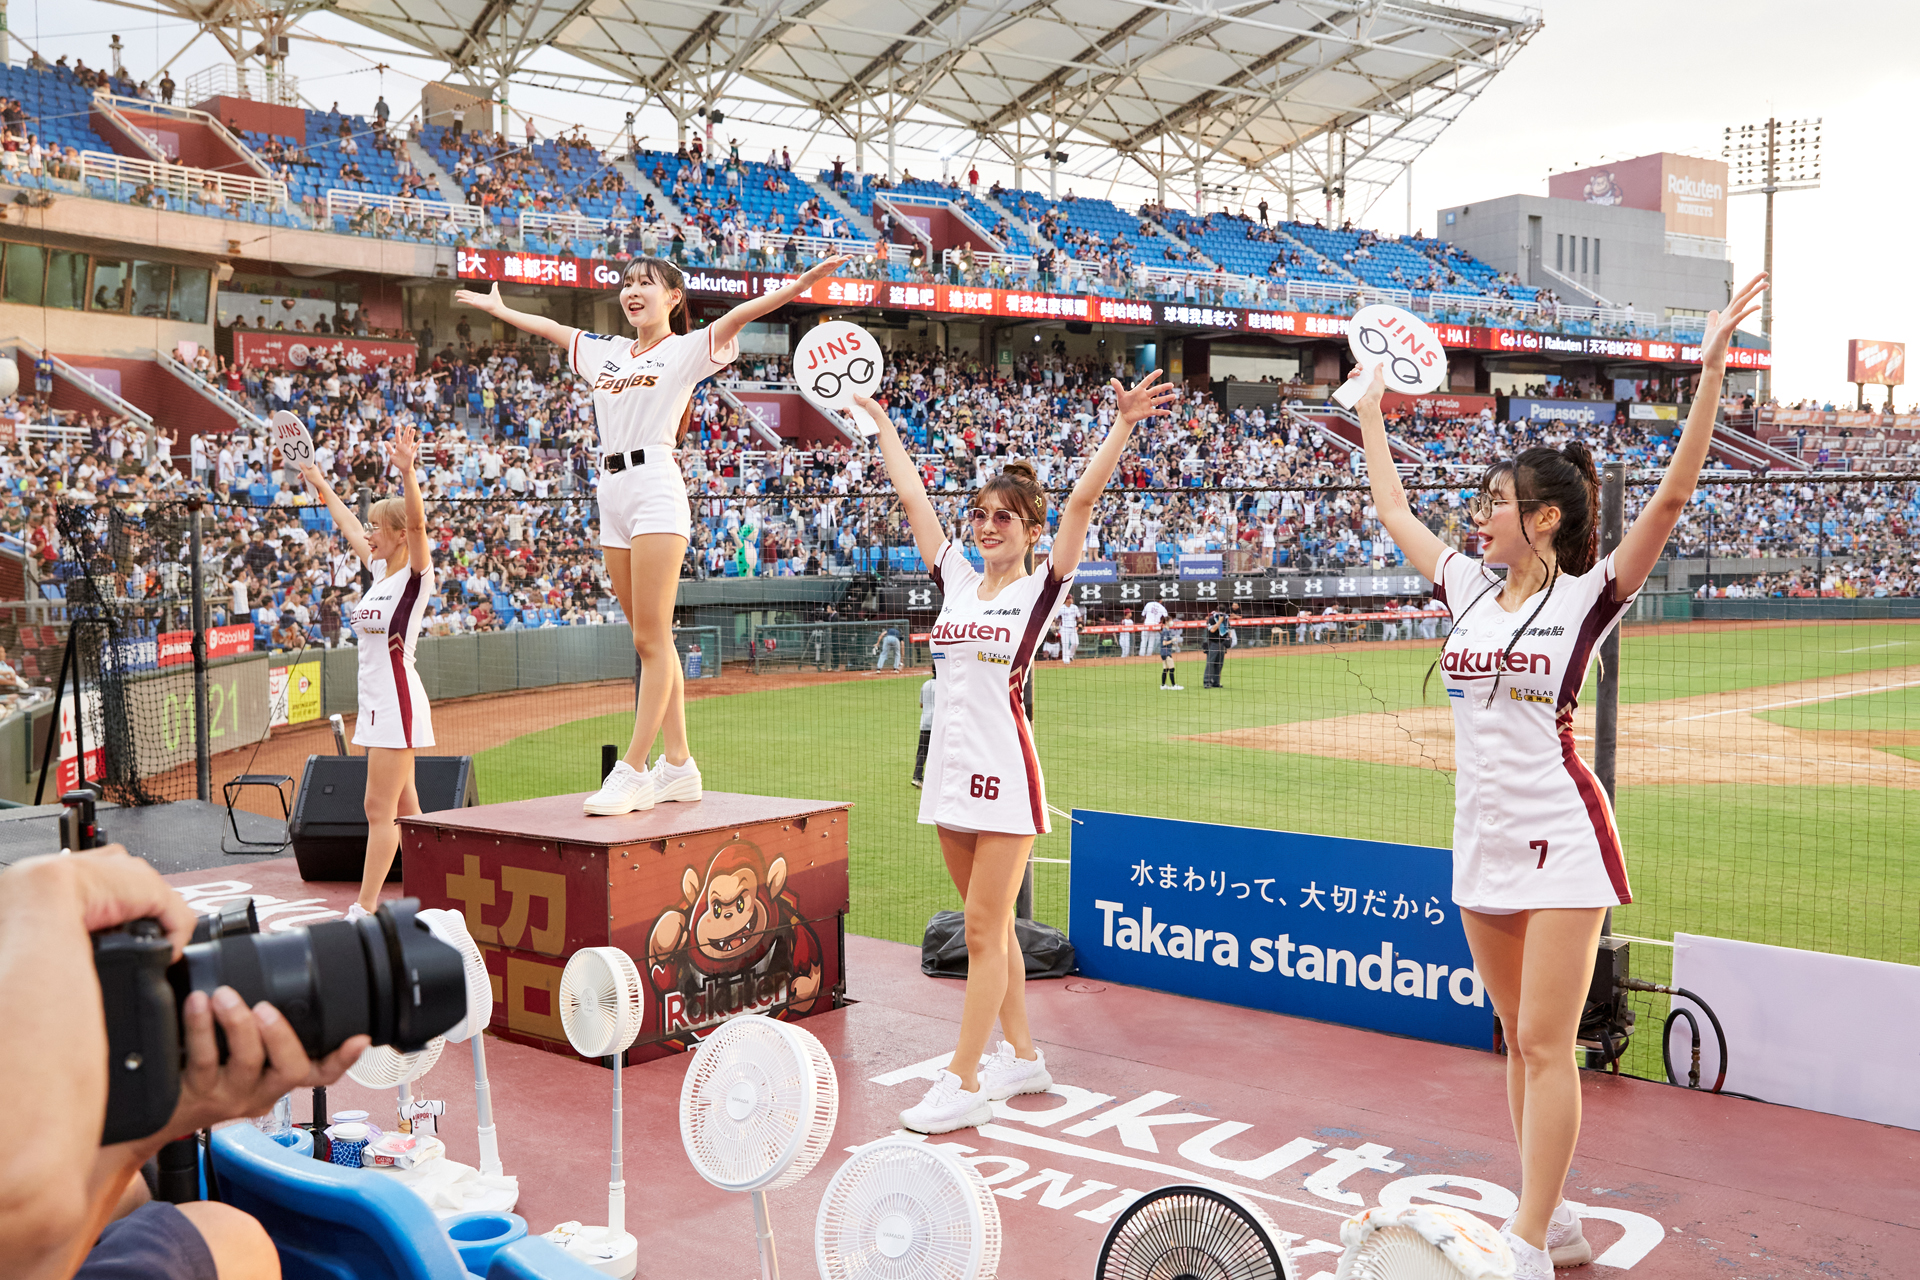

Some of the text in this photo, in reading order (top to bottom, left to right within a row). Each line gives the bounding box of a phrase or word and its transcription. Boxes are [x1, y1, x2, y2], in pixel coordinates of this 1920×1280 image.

[1667, 173, 1723, 201] Rakuten
[1676, 203, 1713, 218] MONKEYS
[504, 256, 577, 282] 誰都不怕
[828, 282, 874, 302] 全壘打
[594, 372, 659, 395] Eagles
[1530, 403, 1595, 422] Panasonic
[1183, 565, 1219, 576] Panasonic
[218, 630, 238, 644] Global
[1524, 688, 1554, 697] TKLAB
[970, 774, 1000, 800] 66
[1529, 840, 1548, 869] 7
[1130, 859, 1446, 925] 水まわりって、大切だから
[1095, 899, 1485, 1007] Takara standard
[665, 973, 789, 1035] Rakuten
[412, 1112, 433, 1120] AIRPORT
[882, 1231, 905, 1240] YAMADA
